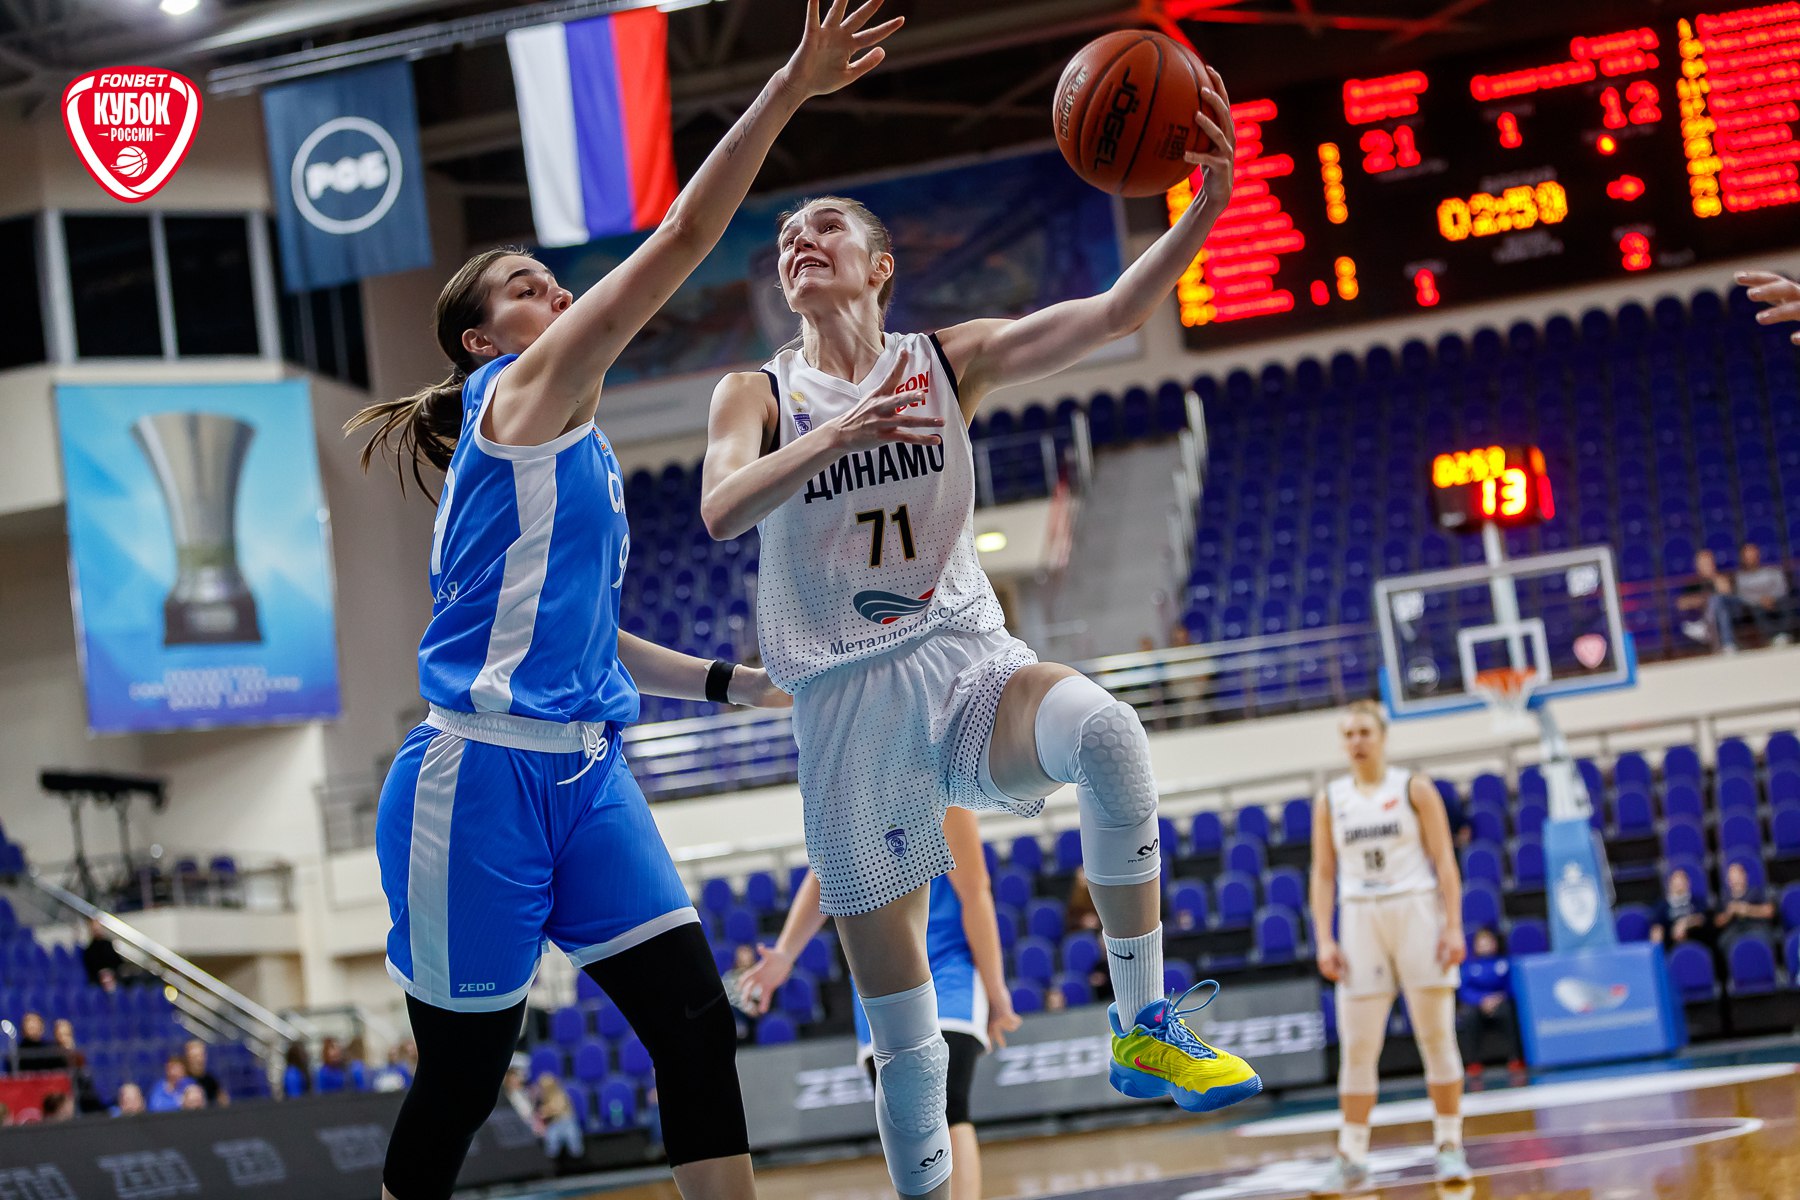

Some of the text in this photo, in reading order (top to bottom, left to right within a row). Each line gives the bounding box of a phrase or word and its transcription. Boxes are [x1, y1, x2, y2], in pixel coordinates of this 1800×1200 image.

[1600, 80, 1662, 129] 12
[1360, 125, 1421, 174] 21
[804, 433, 945, 504] ДИНАМО
[1481, 467, 1527, 517] 13
[855, 503, 918, 569] 71
[458, 982, 496, 993] ZEDO
